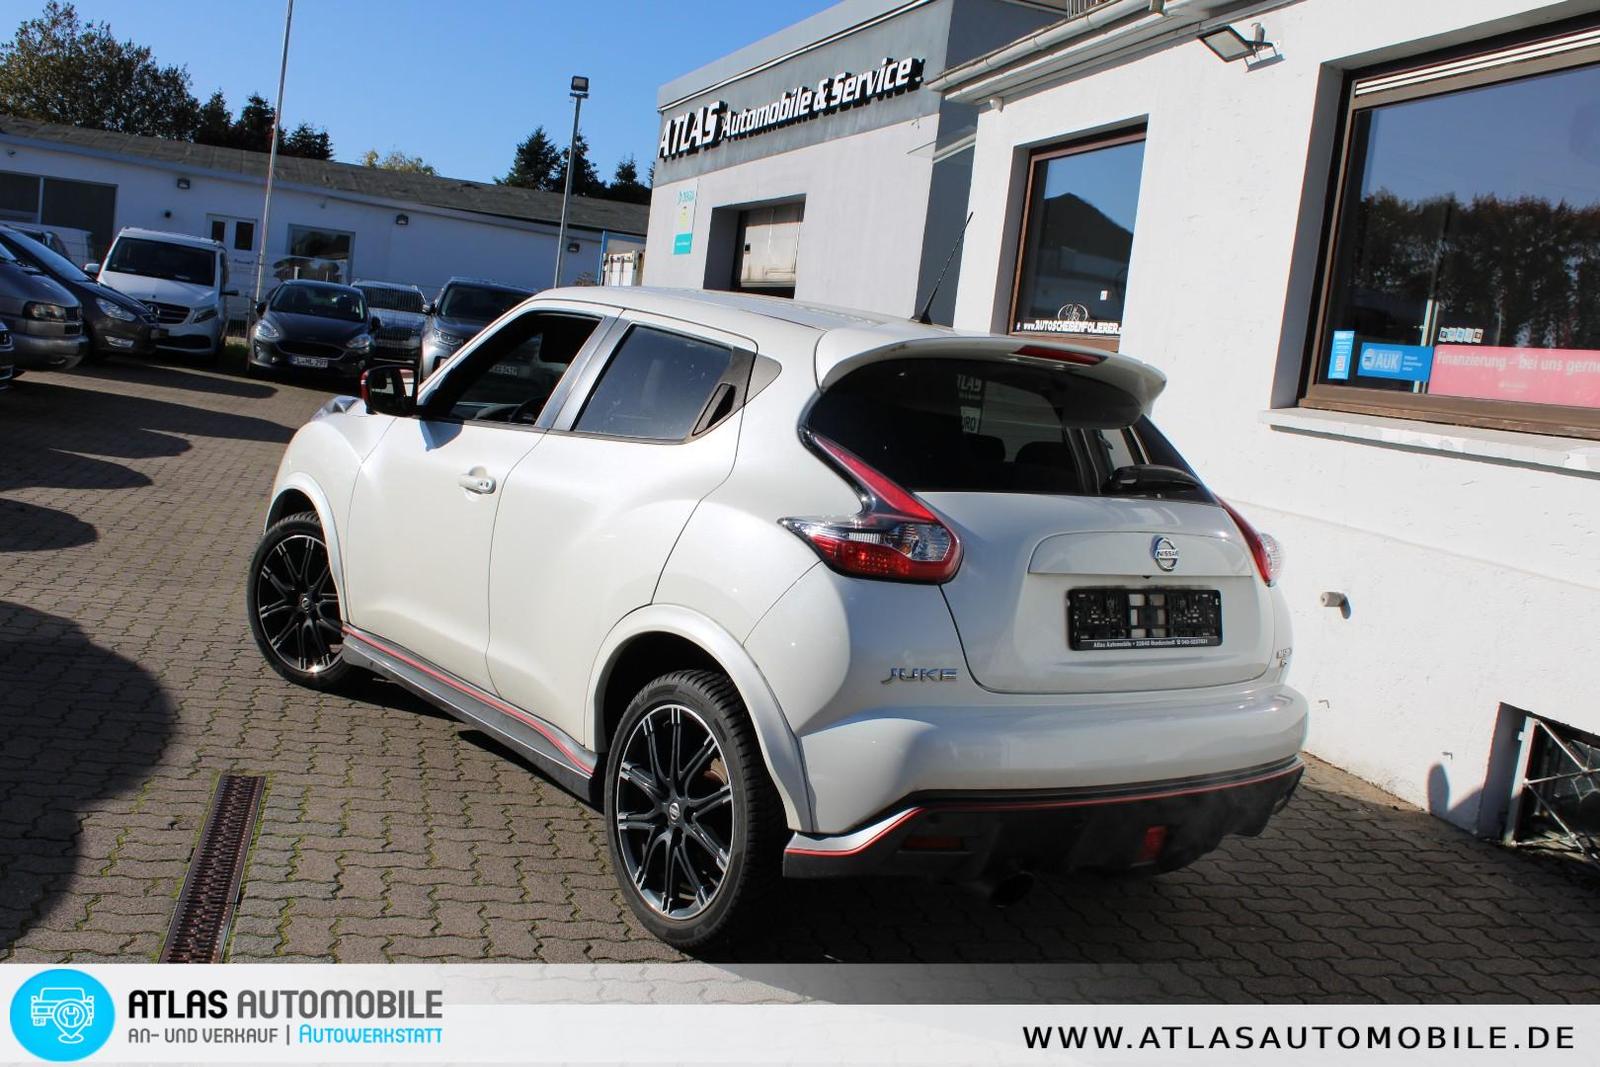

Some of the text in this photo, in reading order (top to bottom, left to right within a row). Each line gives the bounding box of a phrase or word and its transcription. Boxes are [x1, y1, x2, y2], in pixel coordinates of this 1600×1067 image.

[658, 57, 914, 159] ATLAS Automobile & Service
[1375, 350, 1400, 370] AUK
[1436, 351, 1507, 371] Finanzierung
[1541, 357, 1563, 370] uns
[956, 374, 982, 391] TLAS
[881, 668, 958, 685] JUKE
